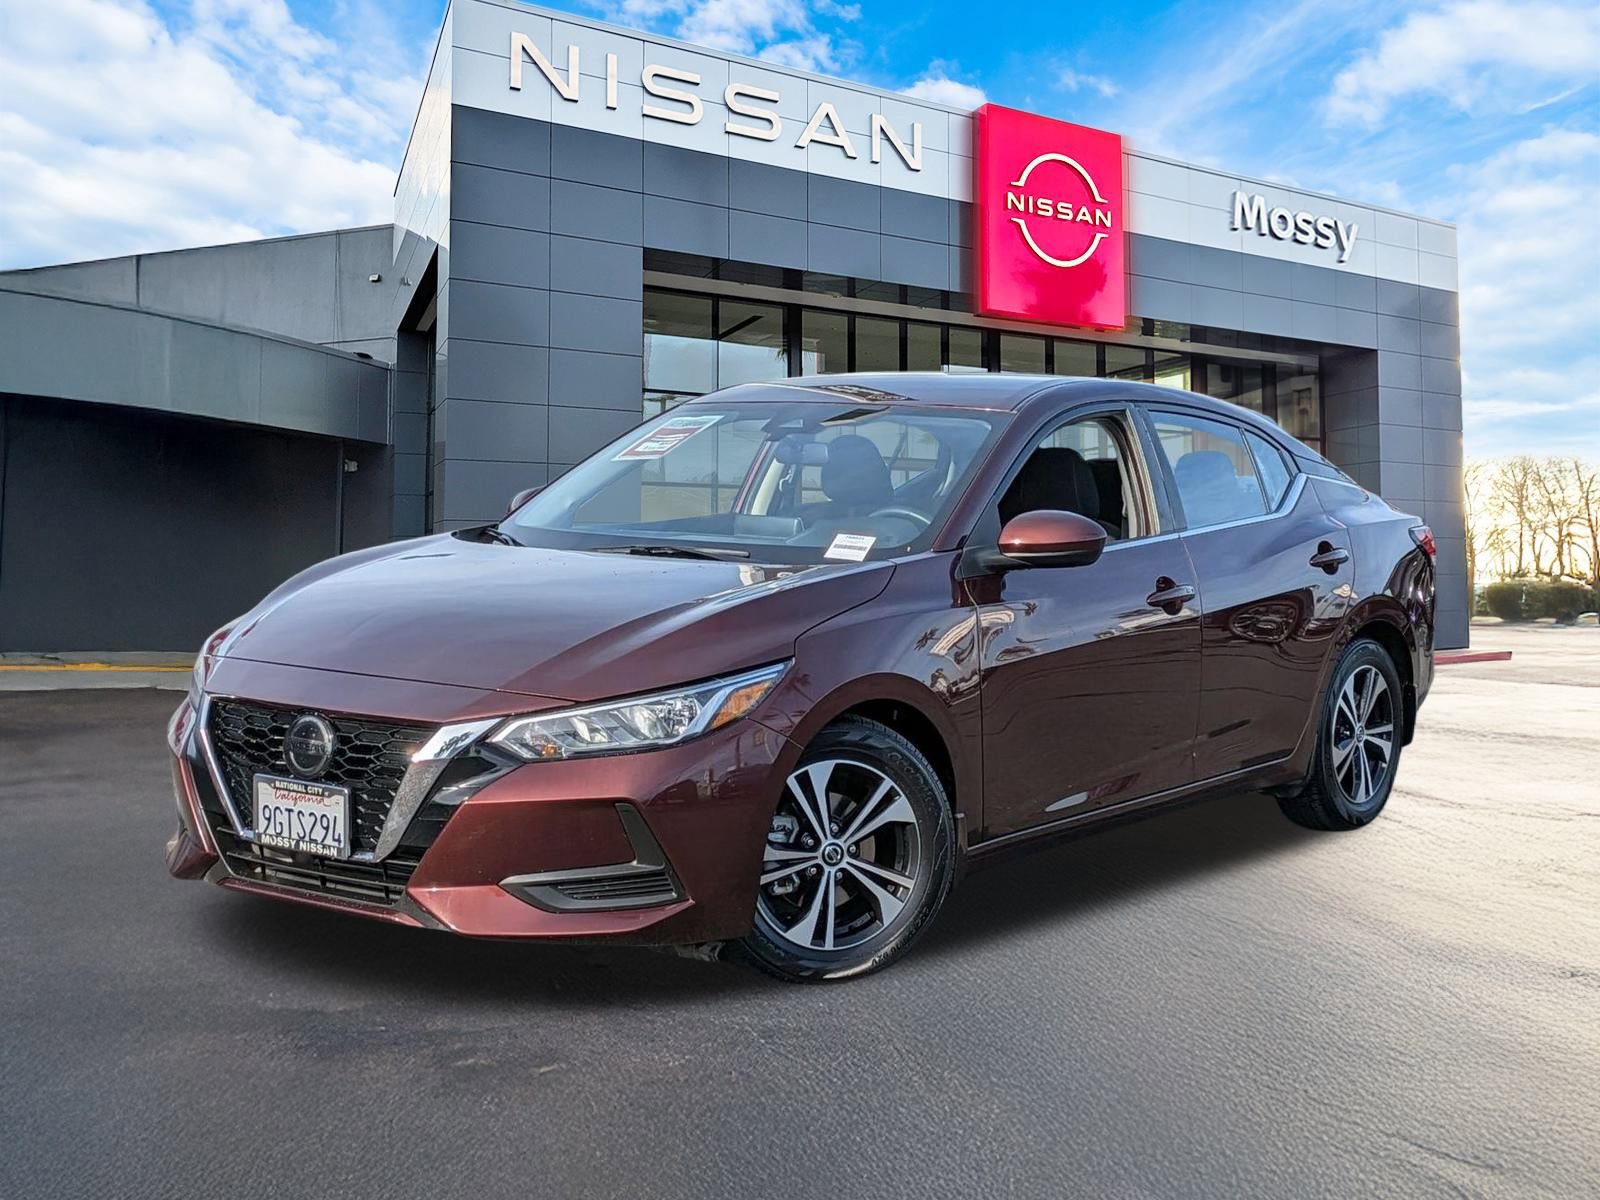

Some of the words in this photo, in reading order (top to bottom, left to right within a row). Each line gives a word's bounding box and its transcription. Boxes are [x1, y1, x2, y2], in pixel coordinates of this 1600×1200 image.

[509, 31, 922, 171] NISSAN
[1006, 191, 1112, 228] NISSAN
[1231, 190, 1360, 263] Mossy
[274, 788, 331, 807] California
[275, 780, 306, 793] NATIONAL
[307, 785, 323, 796] CITY
[262, 804, 342, 845] 9GTS294
[261, 834, 297, 849] MOSSY
[299, 841, 338, 857] NISSAN
